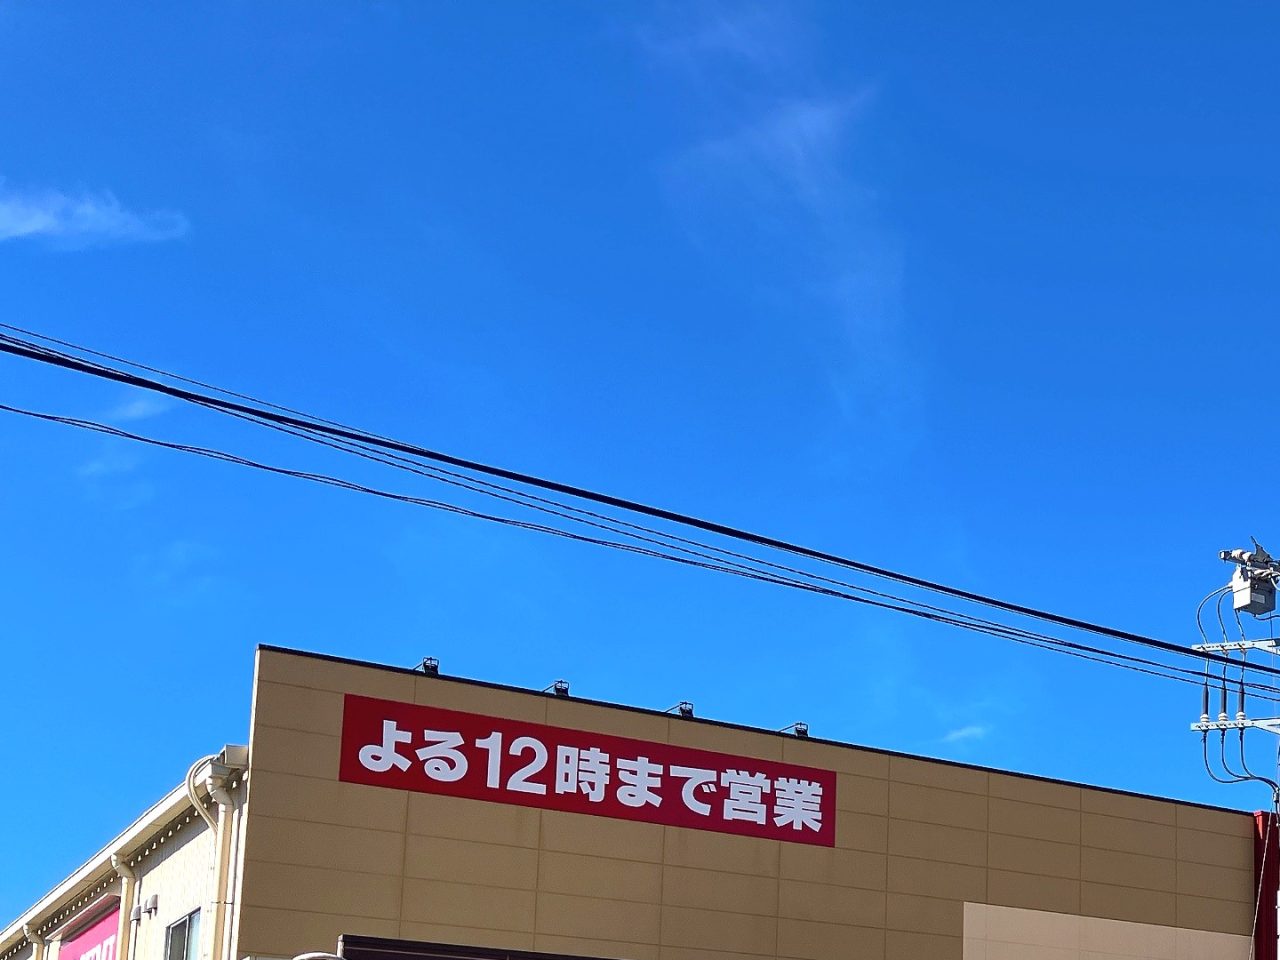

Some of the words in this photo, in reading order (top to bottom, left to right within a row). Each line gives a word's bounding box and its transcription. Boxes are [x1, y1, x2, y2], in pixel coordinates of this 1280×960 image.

[358, 720, 823, 832] よる12時まで営業
